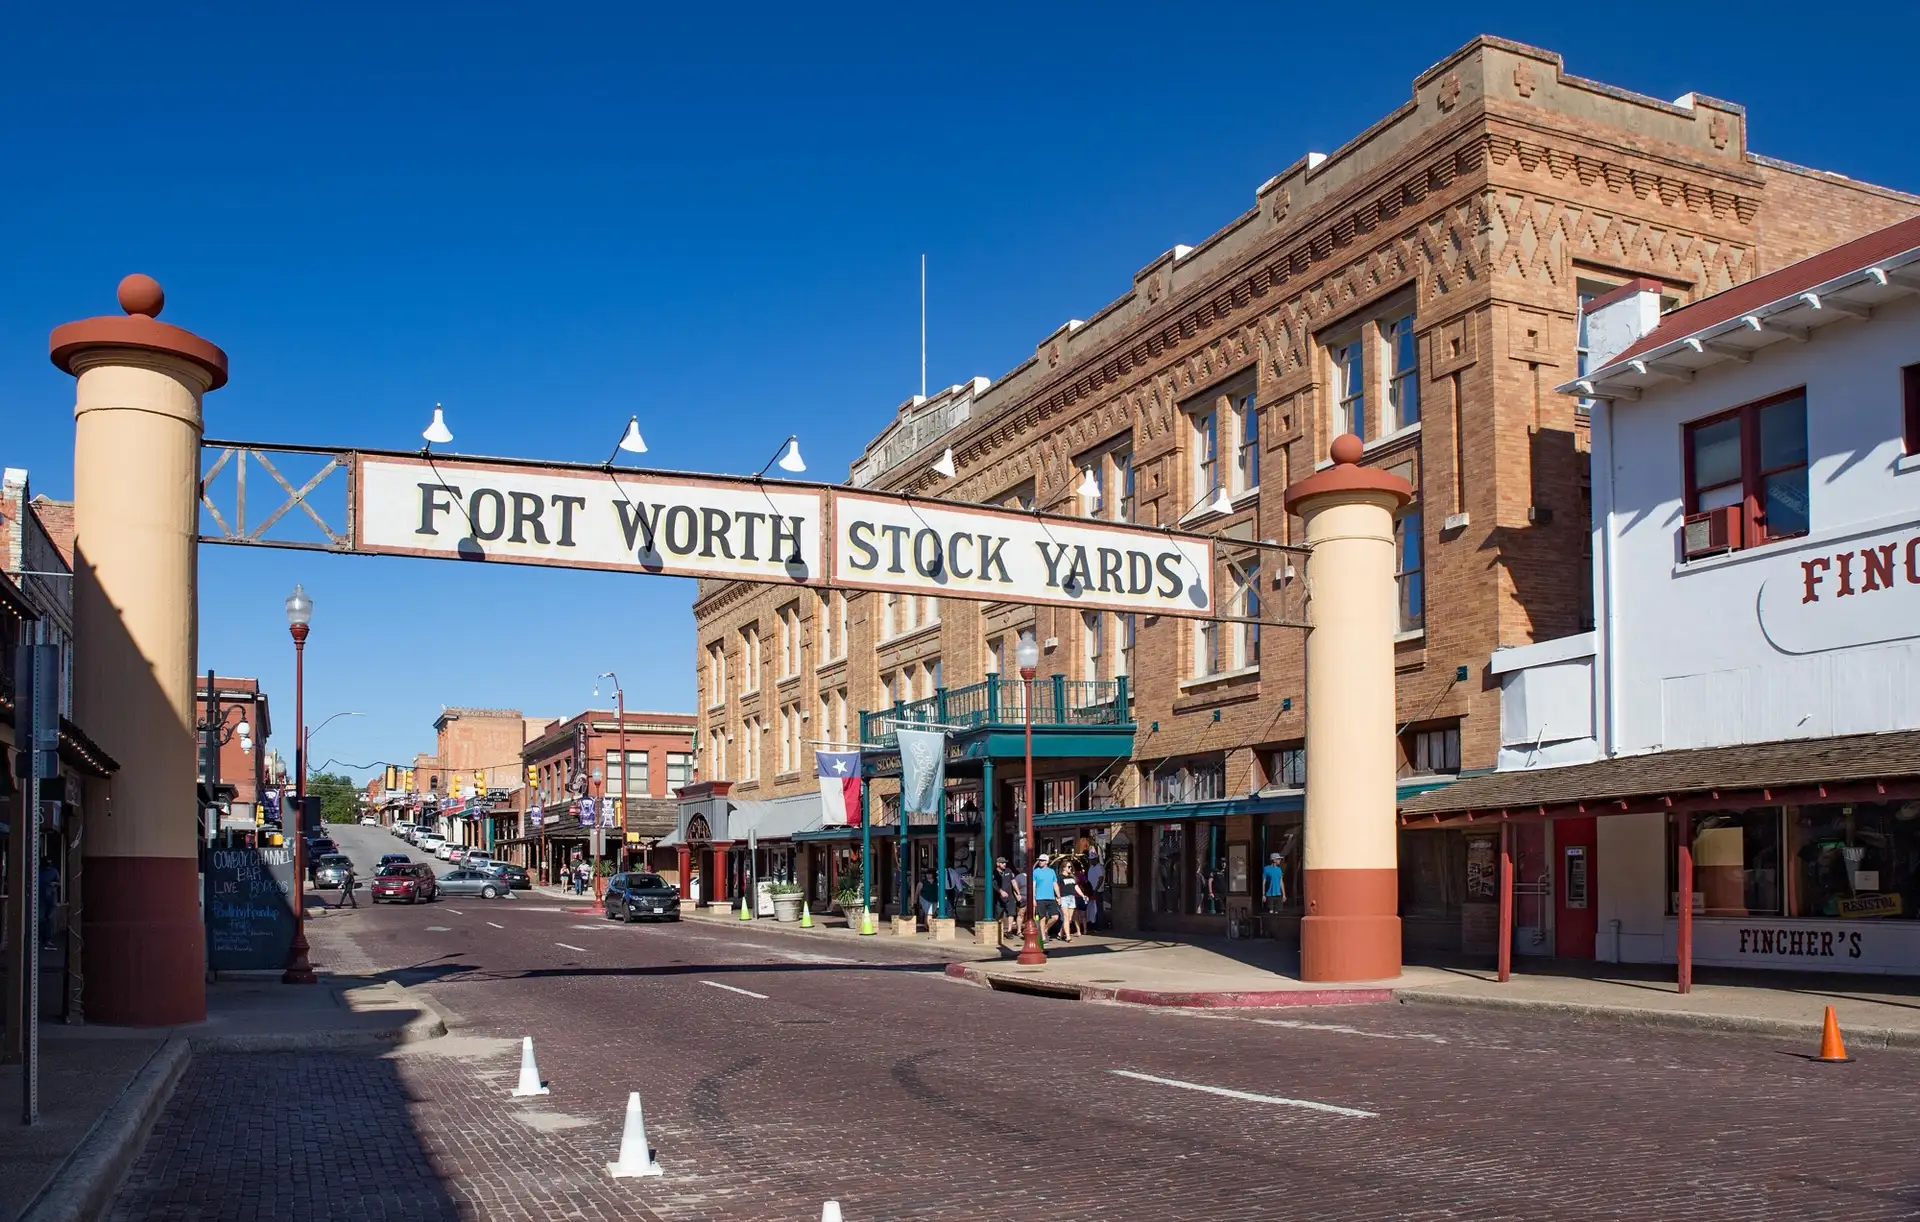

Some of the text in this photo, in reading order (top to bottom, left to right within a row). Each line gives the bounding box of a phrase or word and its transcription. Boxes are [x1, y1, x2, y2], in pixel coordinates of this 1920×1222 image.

[415, 482, 1184, 599] FORT WORTH STOCK YARDS
[214, 850, 292, 869] COWBOY CHANNEL
[237, 867, 261, 882] BAR
[214, 881, 239, 893] LIVE
[1842, 896, 1896, 913] RESISTOL
[1739, 928, 1863, 959] FINCHER'S
